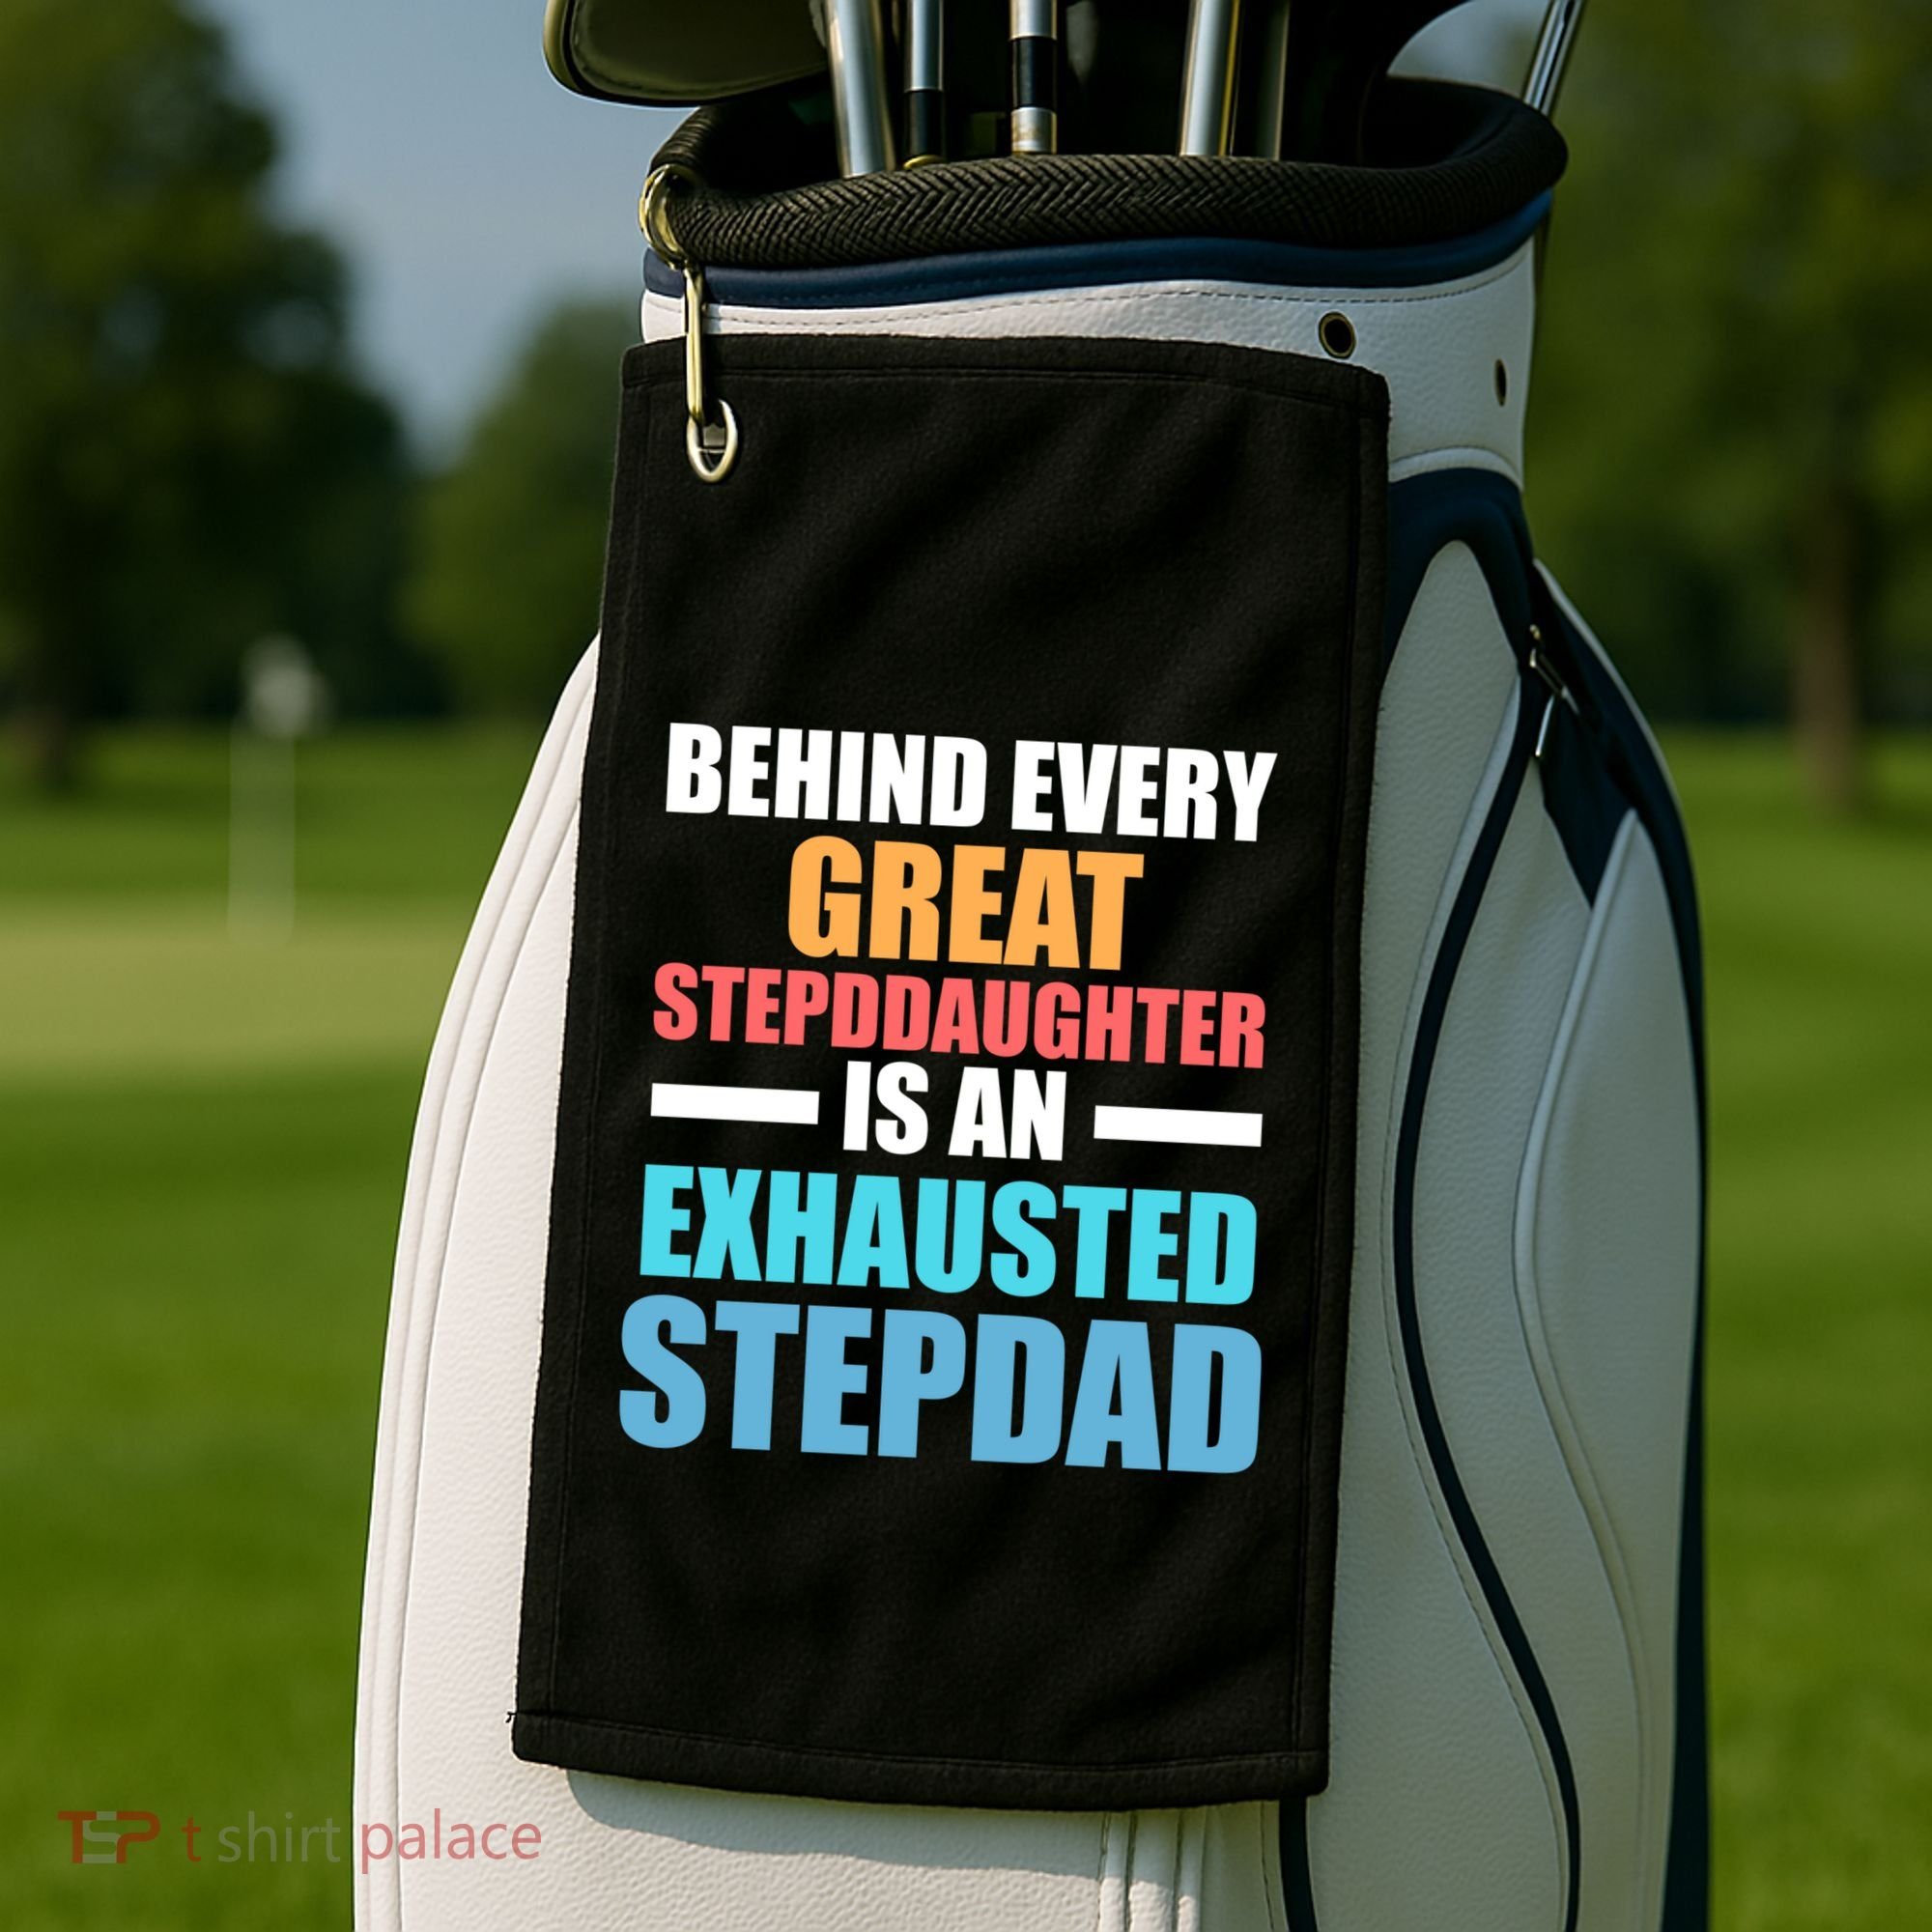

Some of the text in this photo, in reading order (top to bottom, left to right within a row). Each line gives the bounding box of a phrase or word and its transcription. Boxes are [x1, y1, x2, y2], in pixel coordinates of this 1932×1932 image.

[665, 722, 1277, 842] BEHIND EVERY
[787, 836, 1144, 971] GREAT
[654, 962, 1265, 1068] STEPDDAUGHTER
[843, 1061, 1066, 1161] IS AN
[640, 1164, 1257, 1305] EXHAUSTED
[619, 1294, 1263, 1474] STEPDAD
